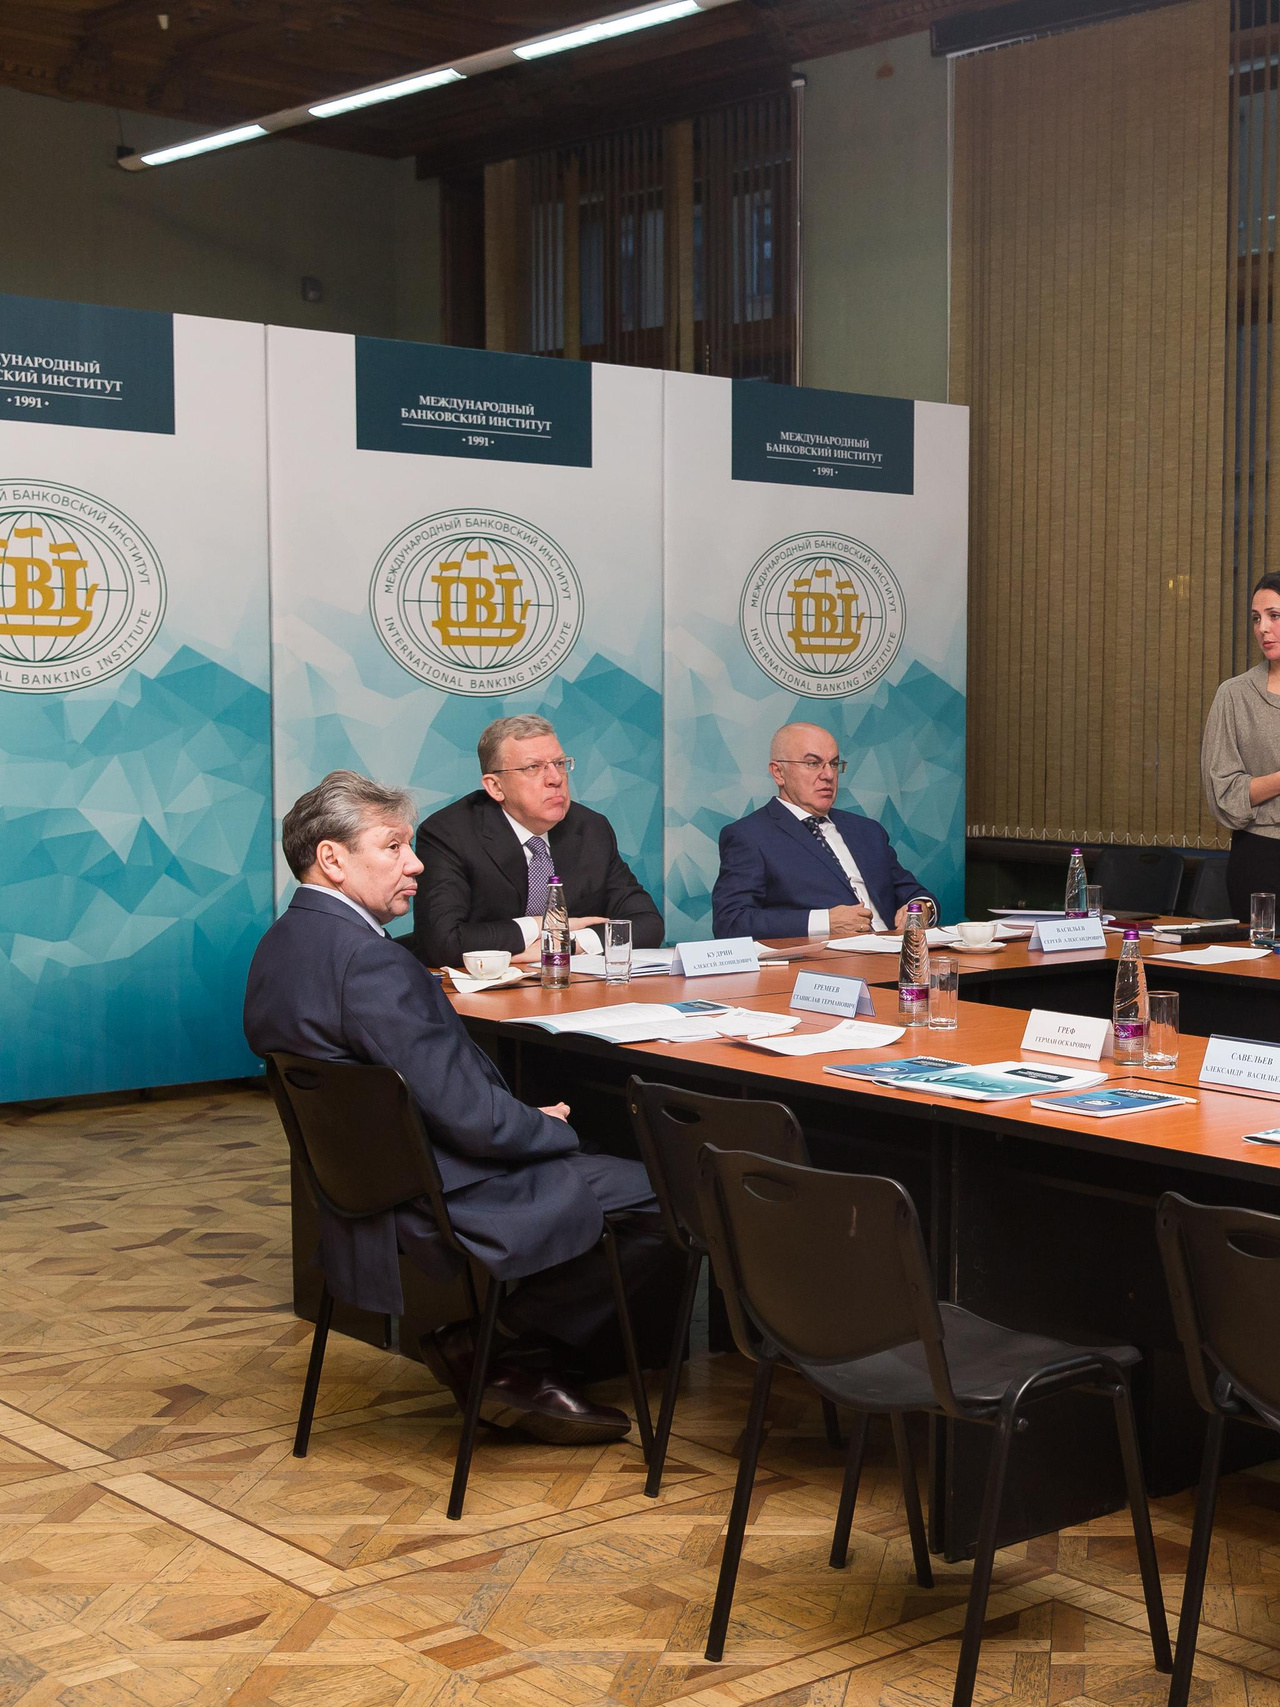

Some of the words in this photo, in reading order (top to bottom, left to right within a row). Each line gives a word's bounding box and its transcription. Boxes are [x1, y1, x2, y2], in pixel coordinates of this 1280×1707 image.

[41, 374, 123, 393] ИНСТИТУТ
[14, 395, 42, 408] 1991
[418, 395, 535, 416] МЕЖДУНАРОДНЫЙ
[401, 408, 486, 426] БАНКОВСКИЙ
[489, 417, 552, 433] ИНСТИТУТ
[467, 435, 489, 447] 1991
[780, 431, 870, 448] МЕЖДУНАРОДНЫЙ
[766, 442, 832, 458] БАНКОВСКИЙ
[833, 449, 883, 464] ИНСТИТУТ
[817, 467, 834, 477] 1991
[12, 489, 107, 524] БАНКОВСКИЙ
[108, 521, 151, 586] ИНСТИТУТ
[384, 517, 462, 594] МЕЖДУНАРОДНЫЙ
[465, 517, 539, 548] БАНКОВСКИЙ
[538, 546, 572, 601] ИНСТИТУТ
[750, 539, 812, 608] МЕЖДУНАРОДНЫЙ
[814, 539, 872, 566] БАНКОВСКИЙ
[870, 563, 897, 613] ИНСТИТУТ
[21, 666, 92, 685] BANKING
[97, 608, 152, 670] INSTITUTE
[384, 616, 463, 687] INTERNATIONAL
[470, 672, 525, 689] BANKING
[529, 620, 572, 676] INSTITUTE
[750, 627, 811, 690] INTERNATIONAL
[816, 676, 860, 692] BANKING
[862, 631, 897, 681] INSTITUTE
[706, 949, 733, 959] КУДРИН
[693, 960, 717, 970] АЛЕКСЕЙ
[717, 957, 753, 968] ЛЕОНИДОВИЧ
[813, 983, 841, 993] ЕРЕМЕЕВ
[793, 993, 821, 1004] СТАНИСЛАВ
[821, 998, 855, 1009] ГЕРМАНОВИЧ
[1057, 1026, 1076, 1035] ГРЕФ
[1035, 1036, 1057, 1045] ГЕРМАН
[1057, 1039, 1092, 1049] ОСКАРОВИЧ
[1231, 1052, 1274, 1065] САВЕЛЬЕВ
[1204, 1065, 1244, 1076] АЛЕКСАНДР
